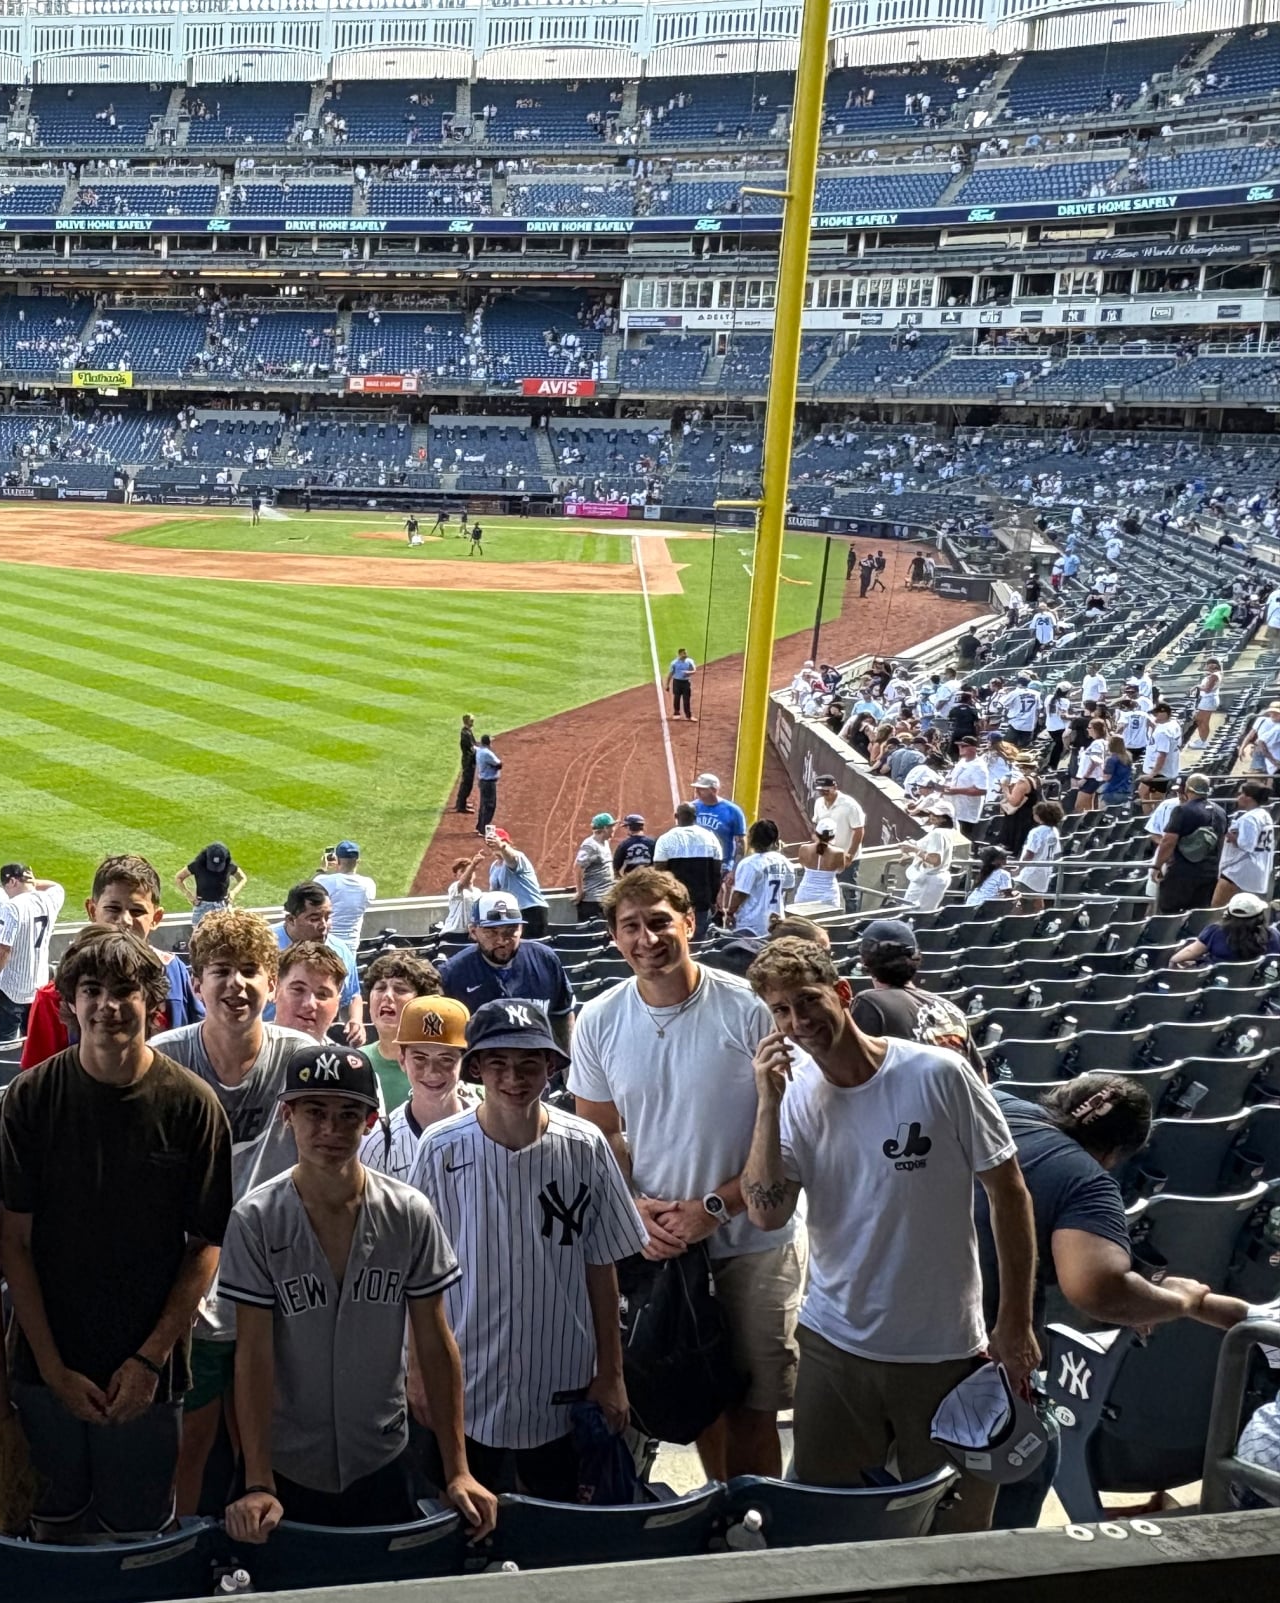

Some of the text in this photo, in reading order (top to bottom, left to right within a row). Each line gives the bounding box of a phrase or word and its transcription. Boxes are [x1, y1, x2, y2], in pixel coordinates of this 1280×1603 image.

[1246, 187, 1274, 201] Ford
[1057, 196, 1178, 217] DRIVE HOME SAFELY
[820, 216, 853, 228] HOME
[855, 214, 899, 226] SAFELY
[967, 208, 997, 222] Ford
[55, 220, 153, 230] DRIVE HOME SAFELY
[206, 219, 232, 231] Ford
[284, 220, 387, 231] DRIVE HOME SAFELY
[448, 219, 474, 232] Ford
[526, 221, 634, 232] DRIVE HOME SAFELY
[694, 218, 722, 231] Ford
[537, 381, 578, 395] AVIS
[768, 879, 781, 904] 7
[33, 915, 49, 949] 7
[504, 1004, 533, 1027] NY
[423, 1010, 444, 1037] NY
[315, 1052, 341, 1081] NY
[537, 1180, 592, 1247] NY
[1057, 1351, 1093, 1400] NY
